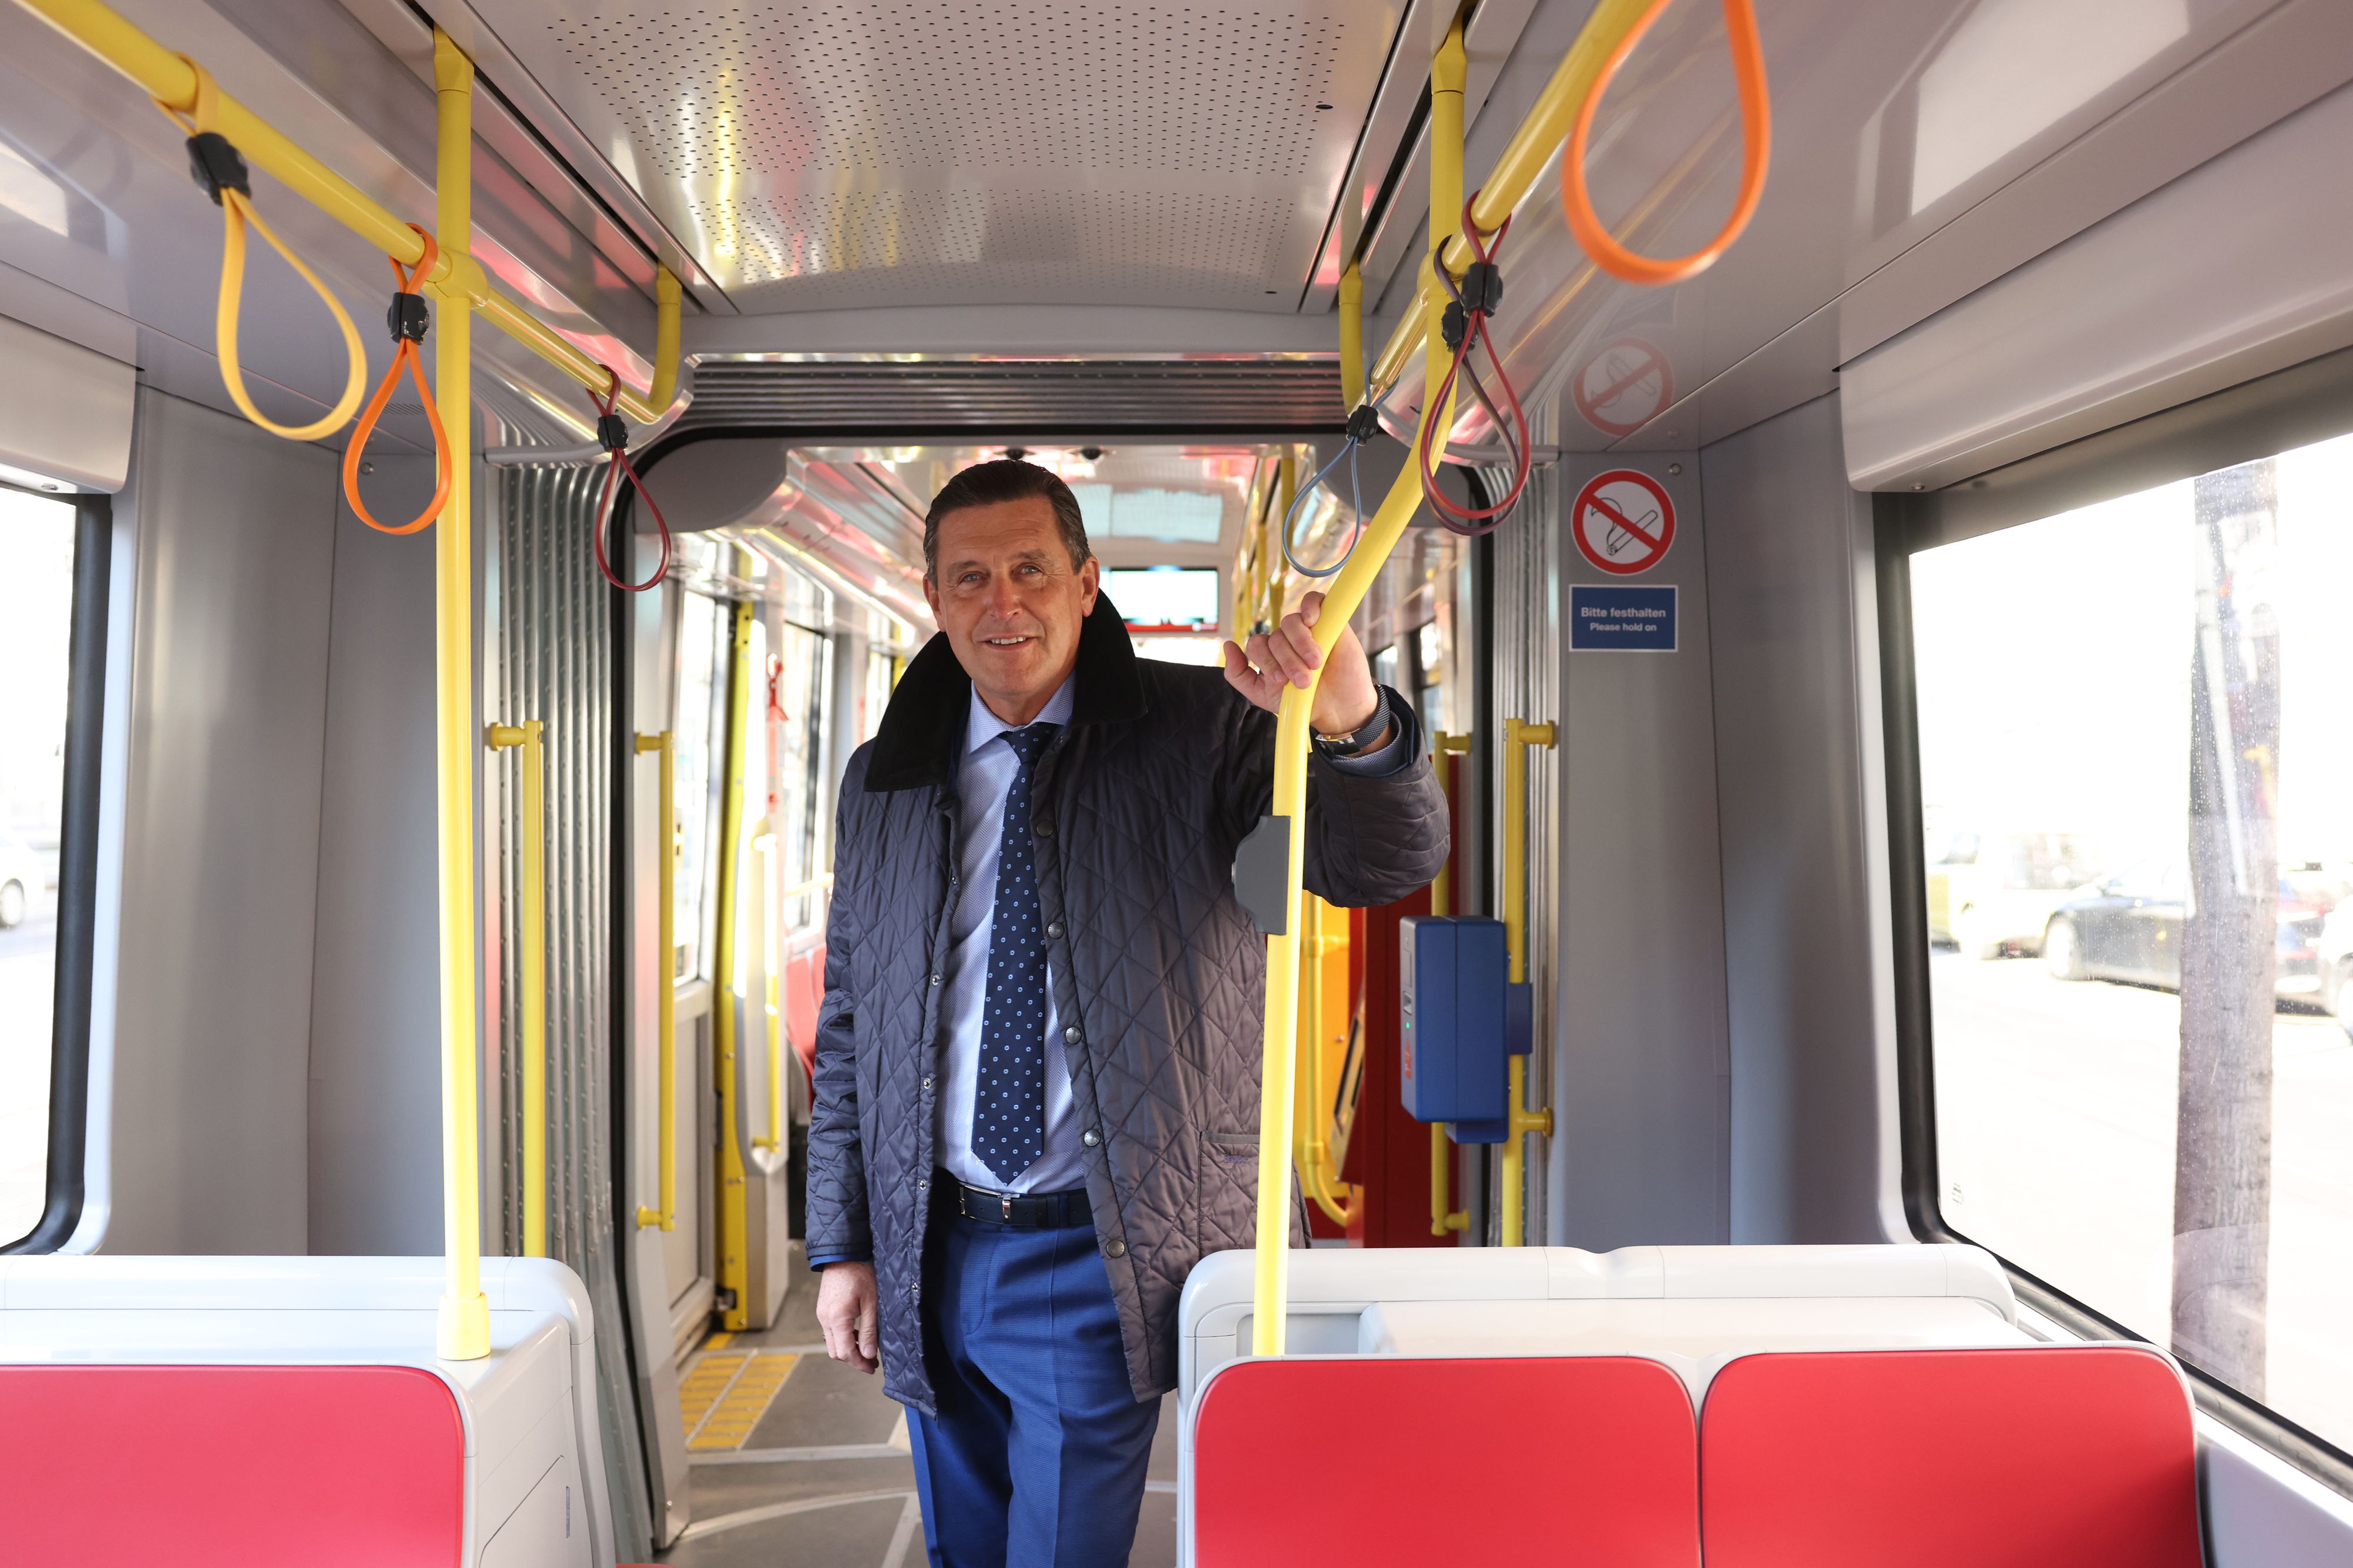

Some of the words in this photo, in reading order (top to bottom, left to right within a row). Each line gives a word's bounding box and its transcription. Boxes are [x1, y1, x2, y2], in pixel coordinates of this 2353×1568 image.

[1581, 607, 1607, 617] Bitte
[1610, 608, 1666, 618] festhalten
[1590, 622, 1620, 630] Please
[1623, 623, 1643, 631] hold
